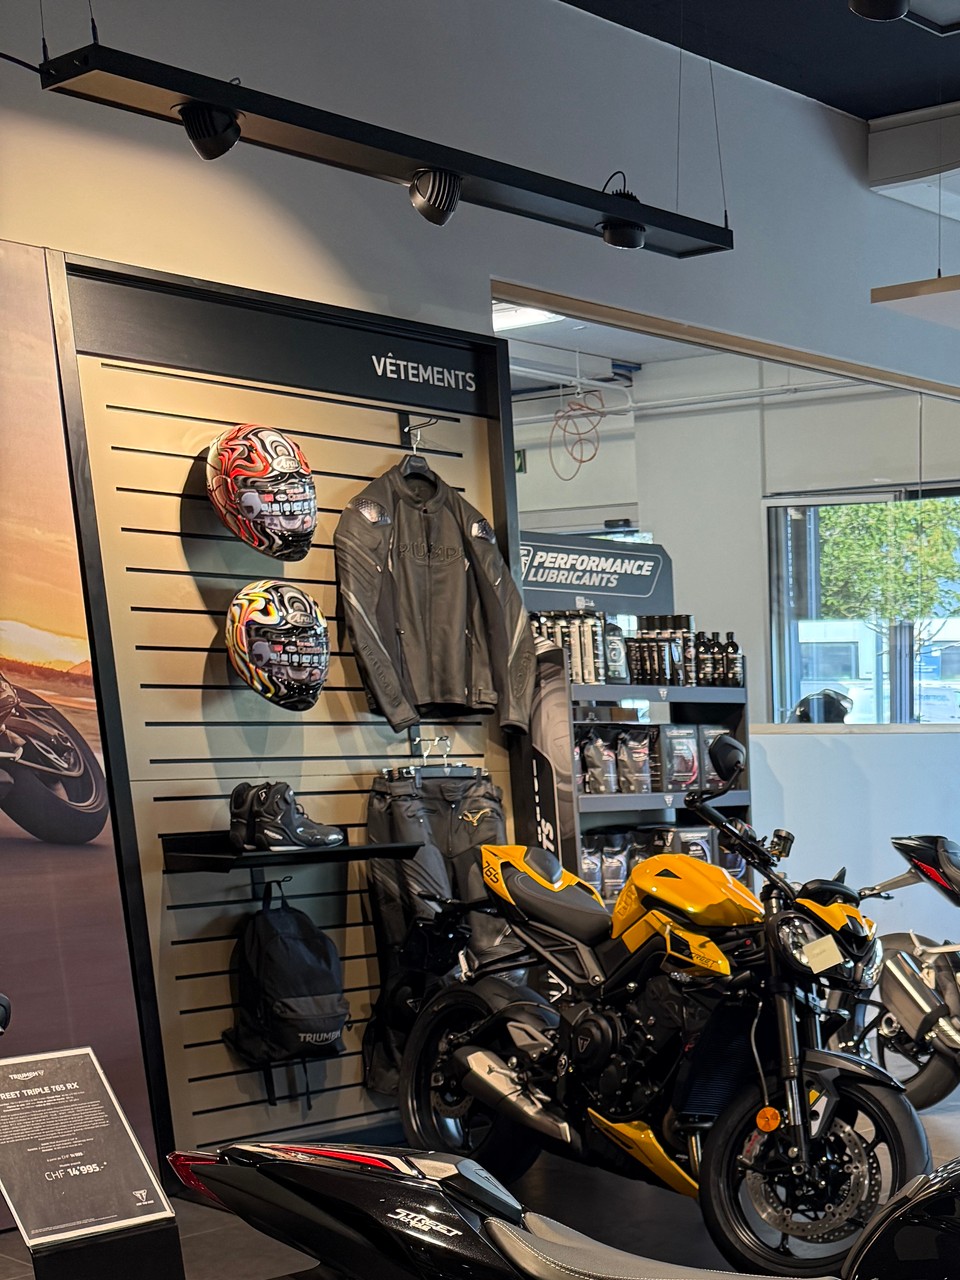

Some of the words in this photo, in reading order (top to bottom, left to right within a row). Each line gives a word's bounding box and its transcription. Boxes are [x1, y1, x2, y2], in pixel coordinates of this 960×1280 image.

[371, 352, 476, 392] VÊTEMENTS
[533, 551, 654, 576] PERFORMANCE
[527, 568, 619, 587] LUBRICANTS
[483, 861, 499, 883] 765
[0, 1090, 20, 1100] REET
[22, 1086, 50, 1097] TRIPLE
[66, 1082, 79, 1090] RX
[44, 1169, 65, 1182] CHF
[387, 1208, 462, 1237] STREET
